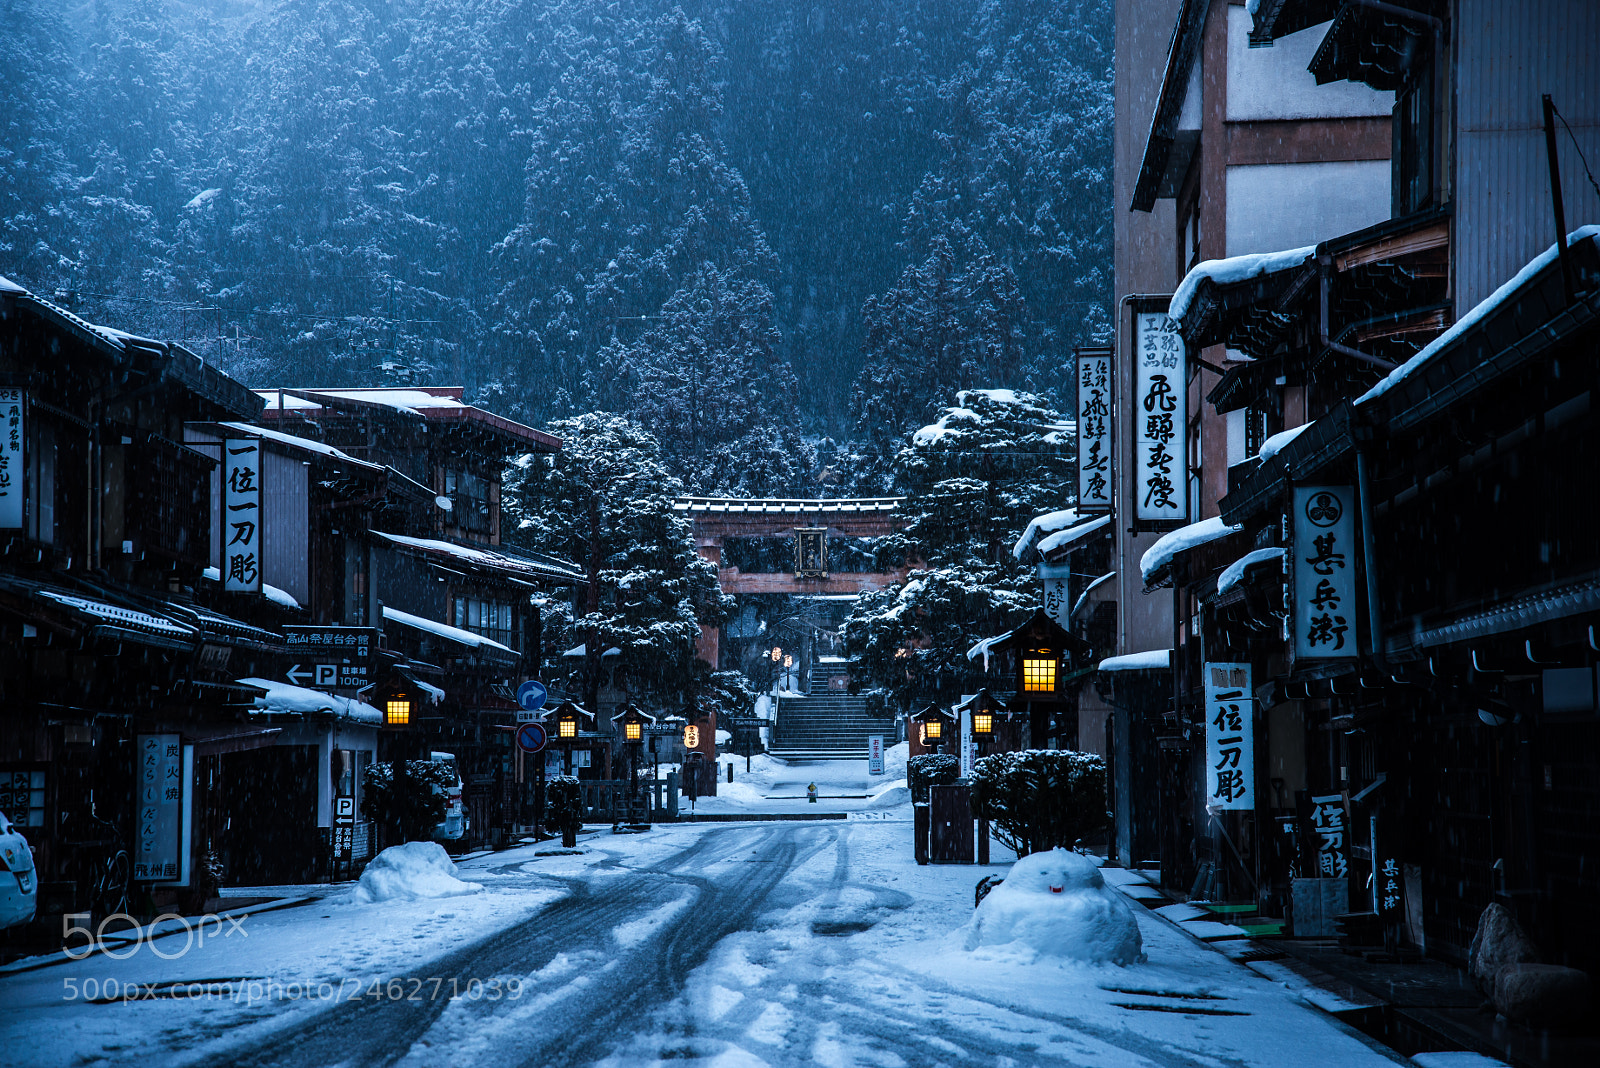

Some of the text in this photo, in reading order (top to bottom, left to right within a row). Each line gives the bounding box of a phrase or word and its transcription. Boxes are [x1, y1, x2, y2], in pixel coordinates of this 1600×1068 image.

[1143, 317, 1160, 367] 工芸品
[1160, 316, 1179, 370] 伝統的
[228, 445, 259, 585] 一位一刀彫
[1306, 532, 1348, 651] 甚兵衛
[286, 632, 370, 645] 高山祭屋台会館
[320, 667, 334, 683] P
[339, 676, 368, 686] 100m
[342, 667, 367, 675] 駐車場
[165, 744, 179, 800] 炭火焼
[1213, 690, 1246, 804] 一位一刀彫
[144, 739, 157, 851] みたらしだんご
[135, 863, 177, 877] 飛州屋
[1381, 858, 1400, 910] 甚兵衛
